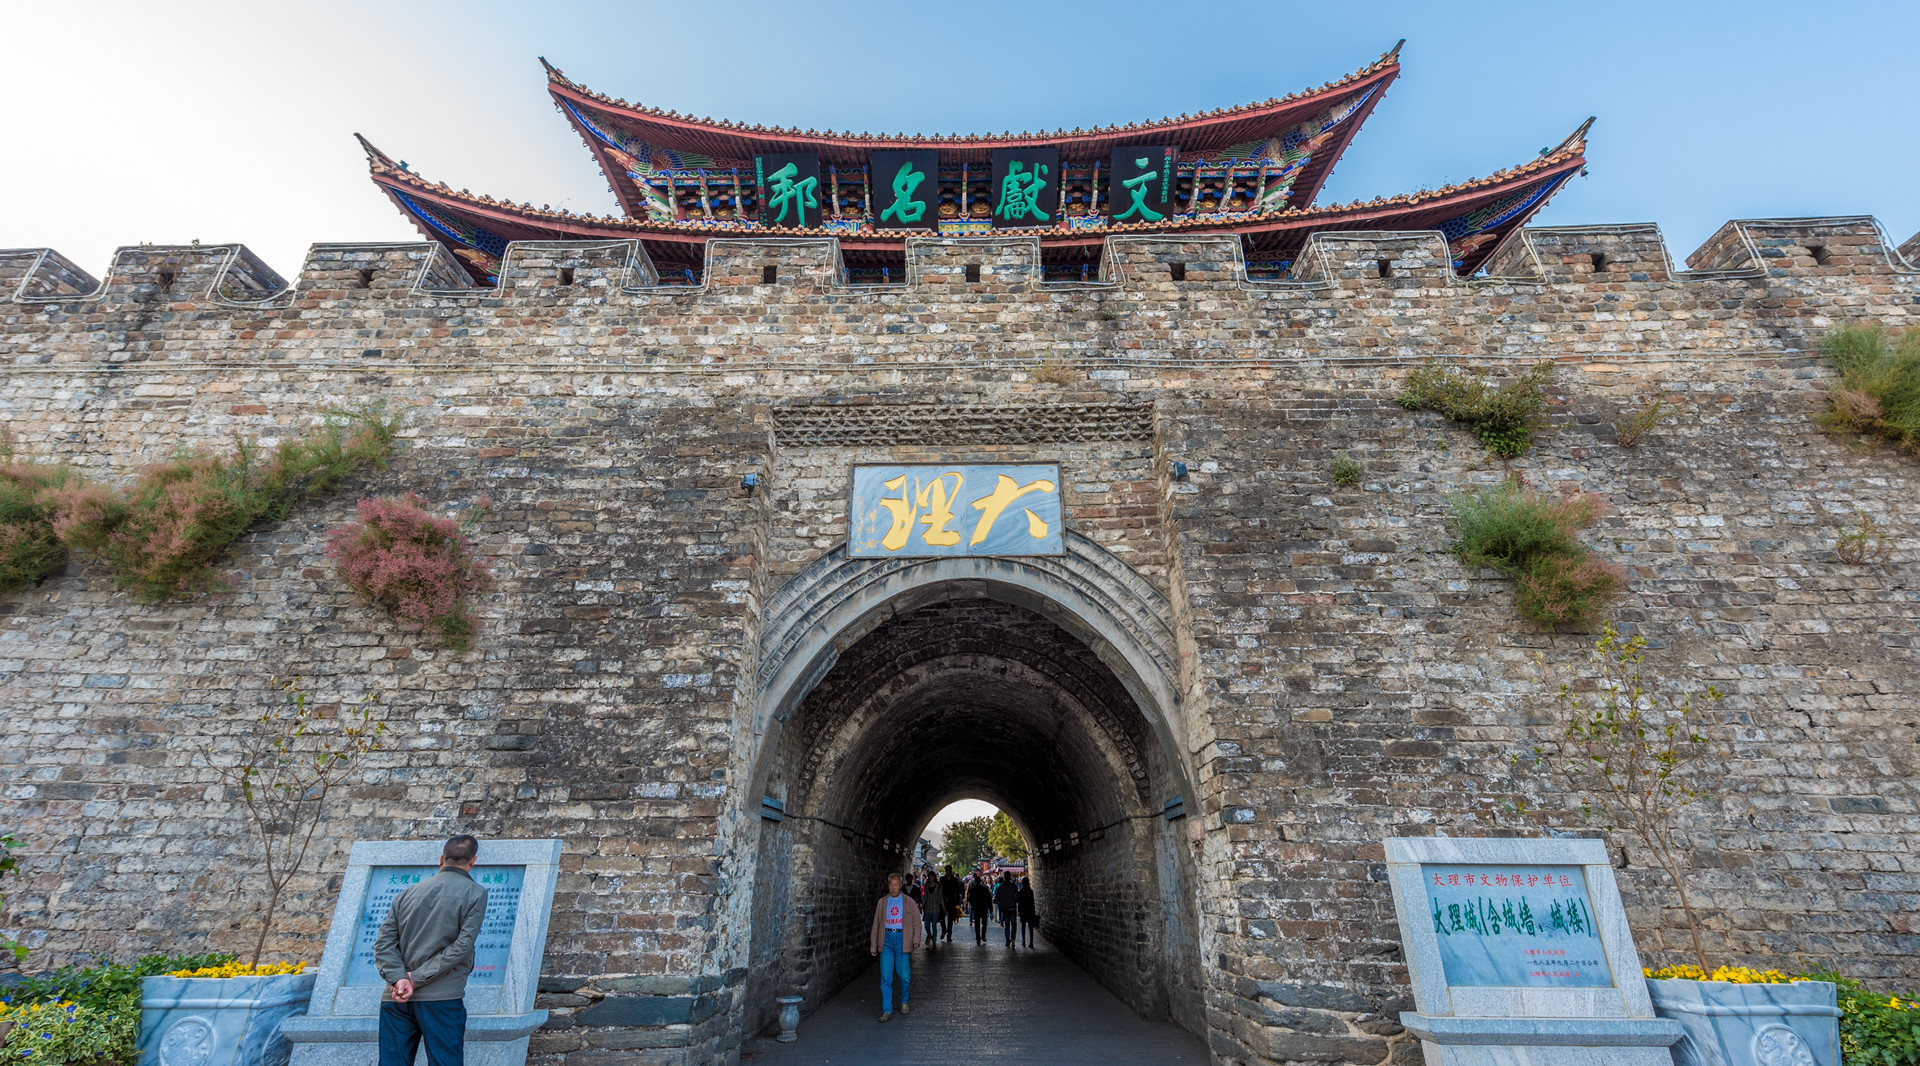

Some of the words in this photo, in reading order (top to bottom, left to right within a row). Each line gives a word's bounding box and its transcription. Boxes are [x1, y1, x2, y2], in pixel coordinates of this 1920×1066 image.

[1433, 872, 1573, 888] 大理市文物保护单位
